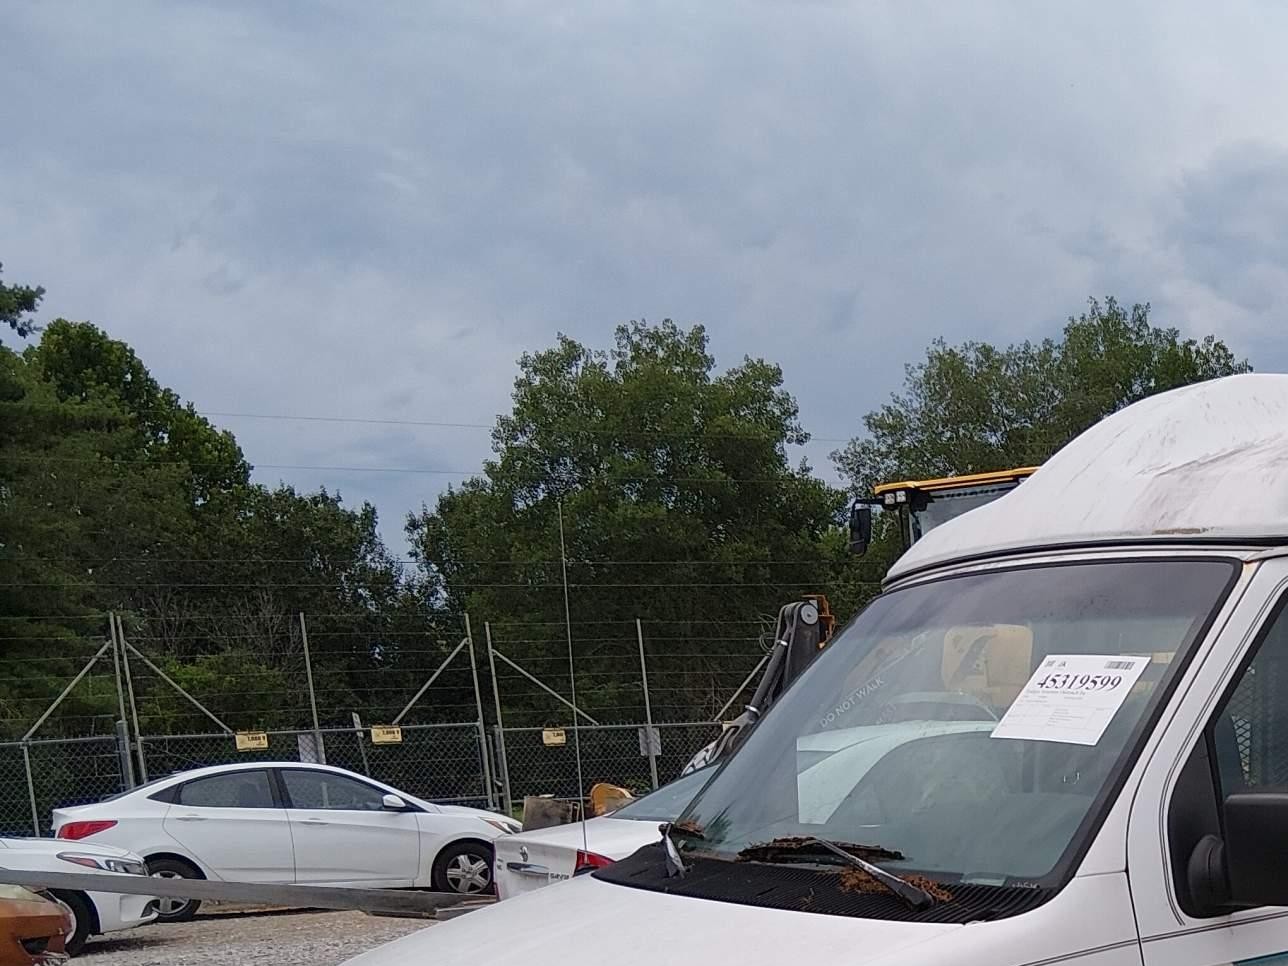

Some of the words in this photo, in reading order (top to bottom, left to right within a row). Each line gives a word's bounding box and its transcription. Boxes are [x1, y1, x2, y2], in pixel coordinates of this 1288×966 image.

[1037, 673, 1122, 691] 45319599
[820, 712, 835, 728] DO
[835, 697, 855, 716] NOT
